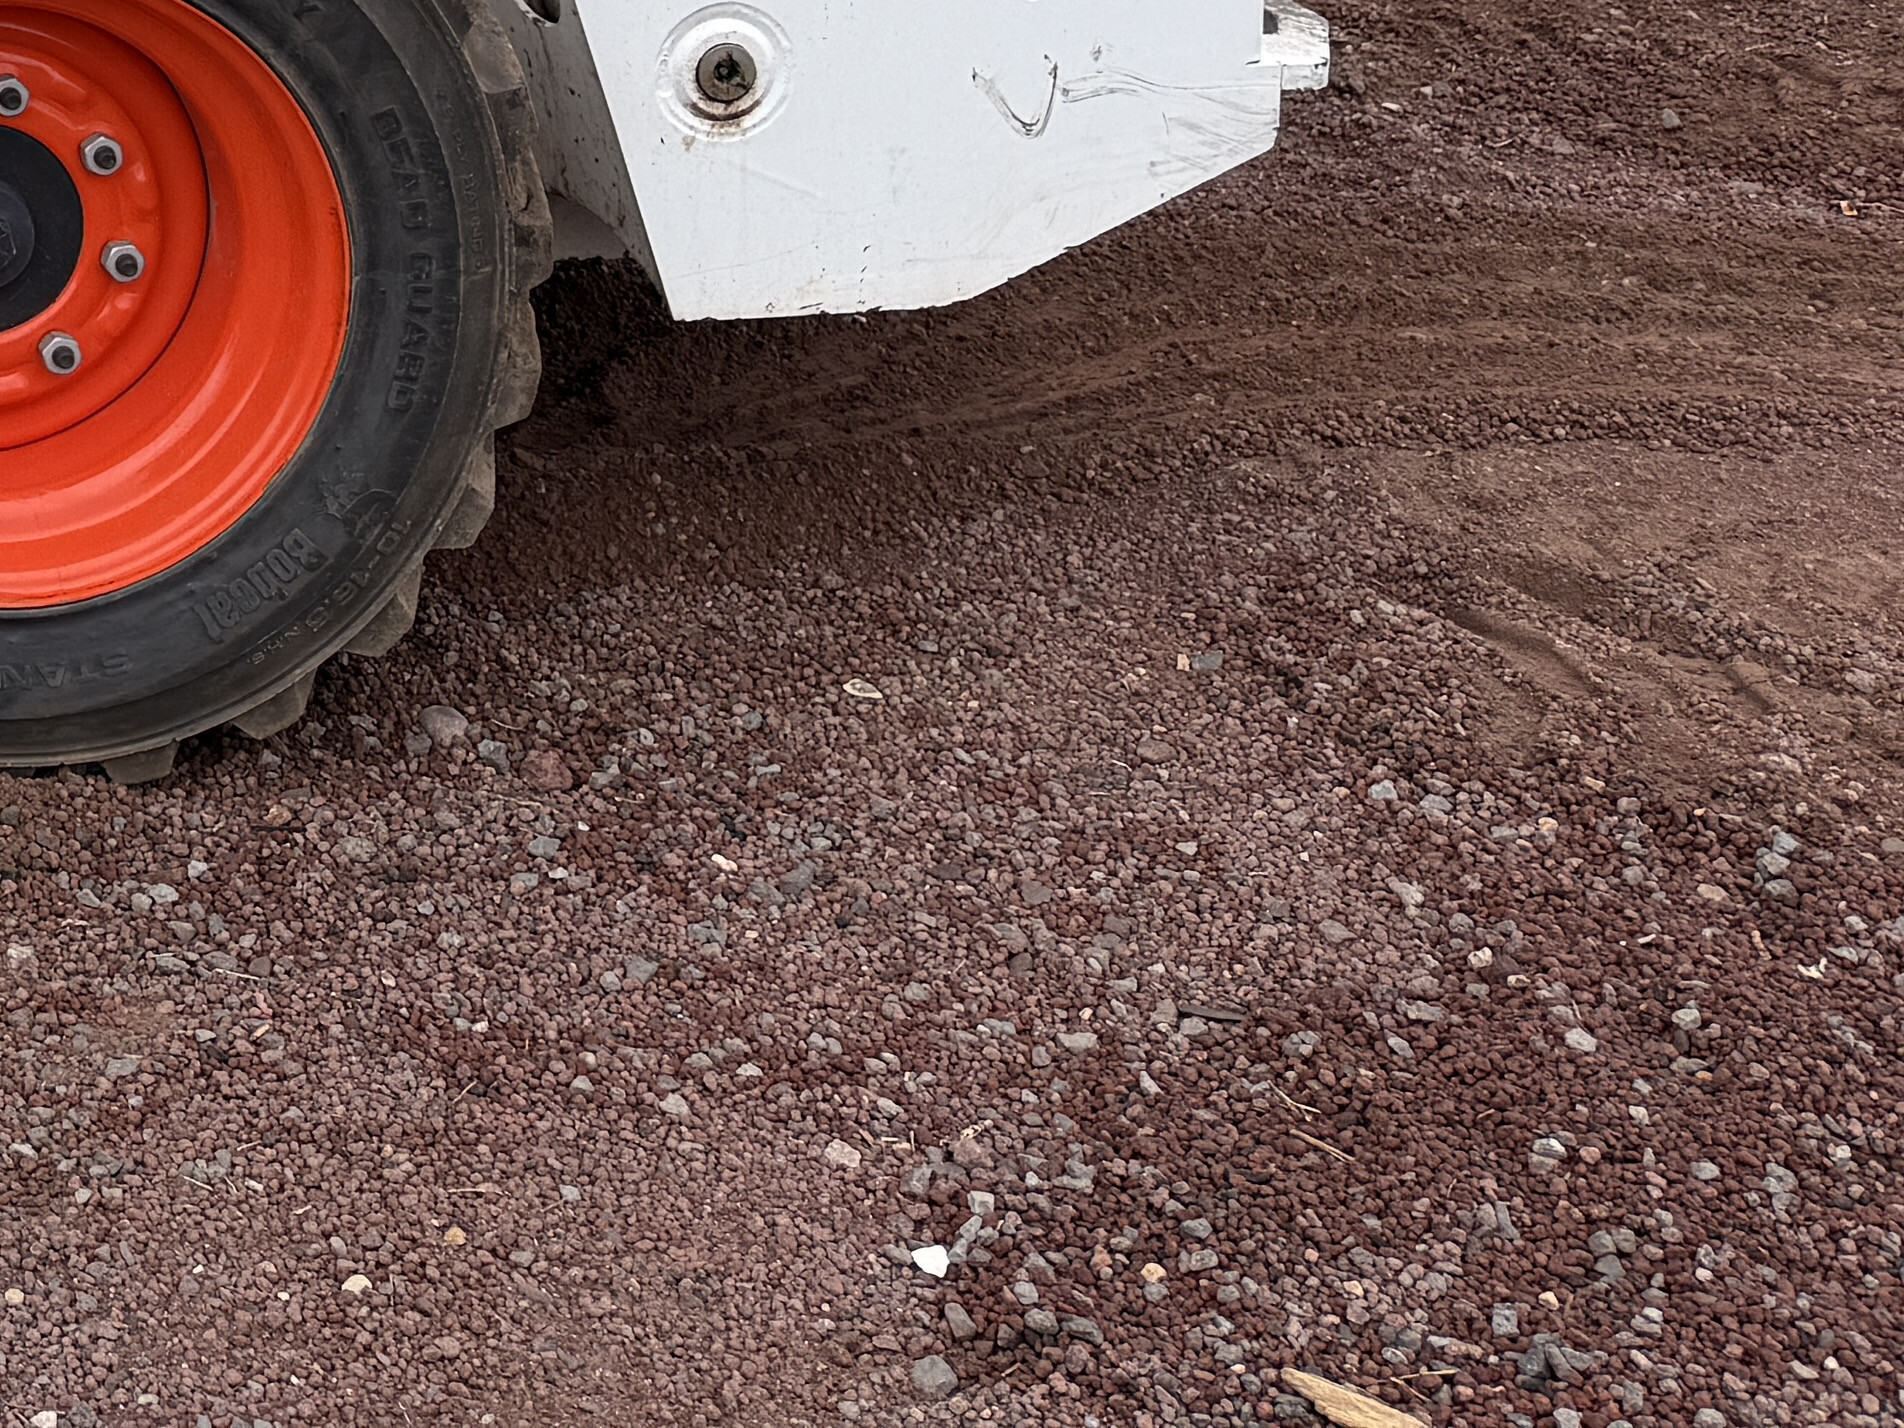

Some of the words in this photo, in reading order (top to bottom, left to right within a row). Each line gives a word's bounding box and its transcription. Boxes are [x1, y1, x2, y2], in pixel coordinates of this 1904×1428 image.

[367, 104, 432, 230] BEAD
[382, 251, 435, 418] GUARD
[189, 524, 332, 649] Bobcat
[301, 510, 415, 635] 10-16.5
